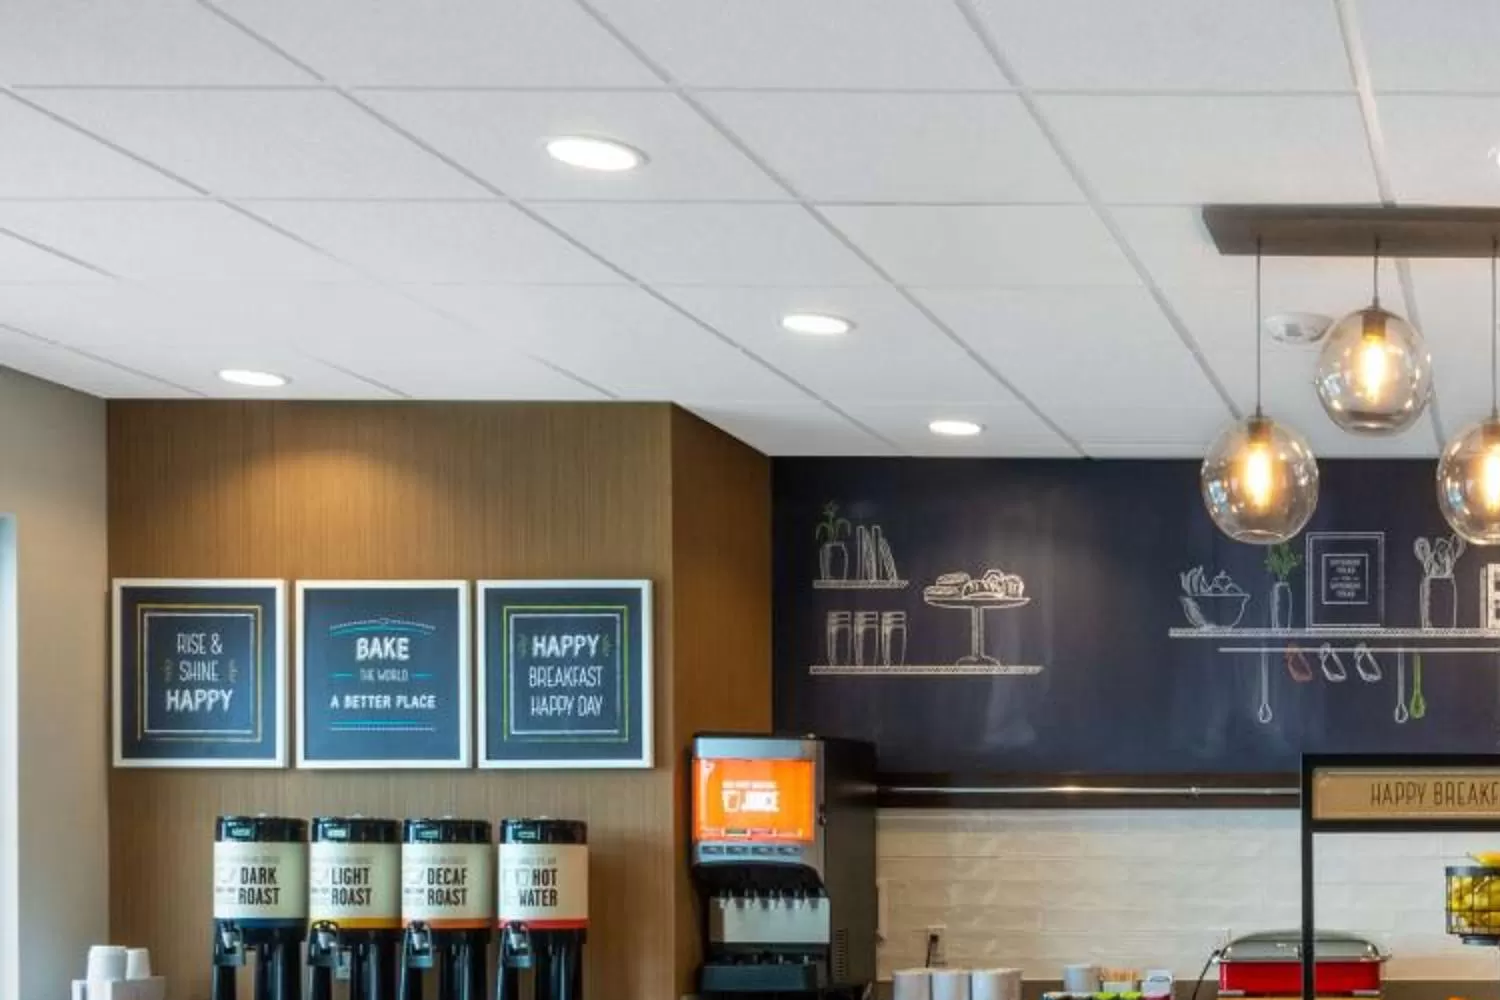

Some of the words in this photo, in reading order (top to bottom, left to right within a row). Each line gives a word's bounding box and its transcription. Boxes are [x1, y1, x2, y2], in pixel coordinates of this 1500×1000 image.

[177, 632, 207, 655] RISE
[211, 632, 223, 655] &
[356, 637, 410, 660] BAKE
[532, 634, 600, 658] HAPPY
[179, 660, 219, 681] SHINE
[377, 668, 408, 681] WORLD
[528, 665, 603, 688] BREAKFAST
[166, 688, 233, 712] HAPPY
[330, 695, 340, 709] A
[344, 695, 391, 709] BETTER
[395, 695, 436, 709] PLACE
[531, 695, 575, 716] HAPPY
[577, 695, 603, 716] DAY
[1370, 781, 1427, 806] HAPPY
[240, 867, 277, 885] DARK
[331, 867, 371, 885] LIGHT
[427, 867, 468, 885] DECAF
[531, 868, 558, 886] HOT
[238, 887, 281, 905] ROAST
[331, 888, 372, 905] ROAST
[427, 888, 468, 906] ROAST
[518, 888, 558, 906] WATER
